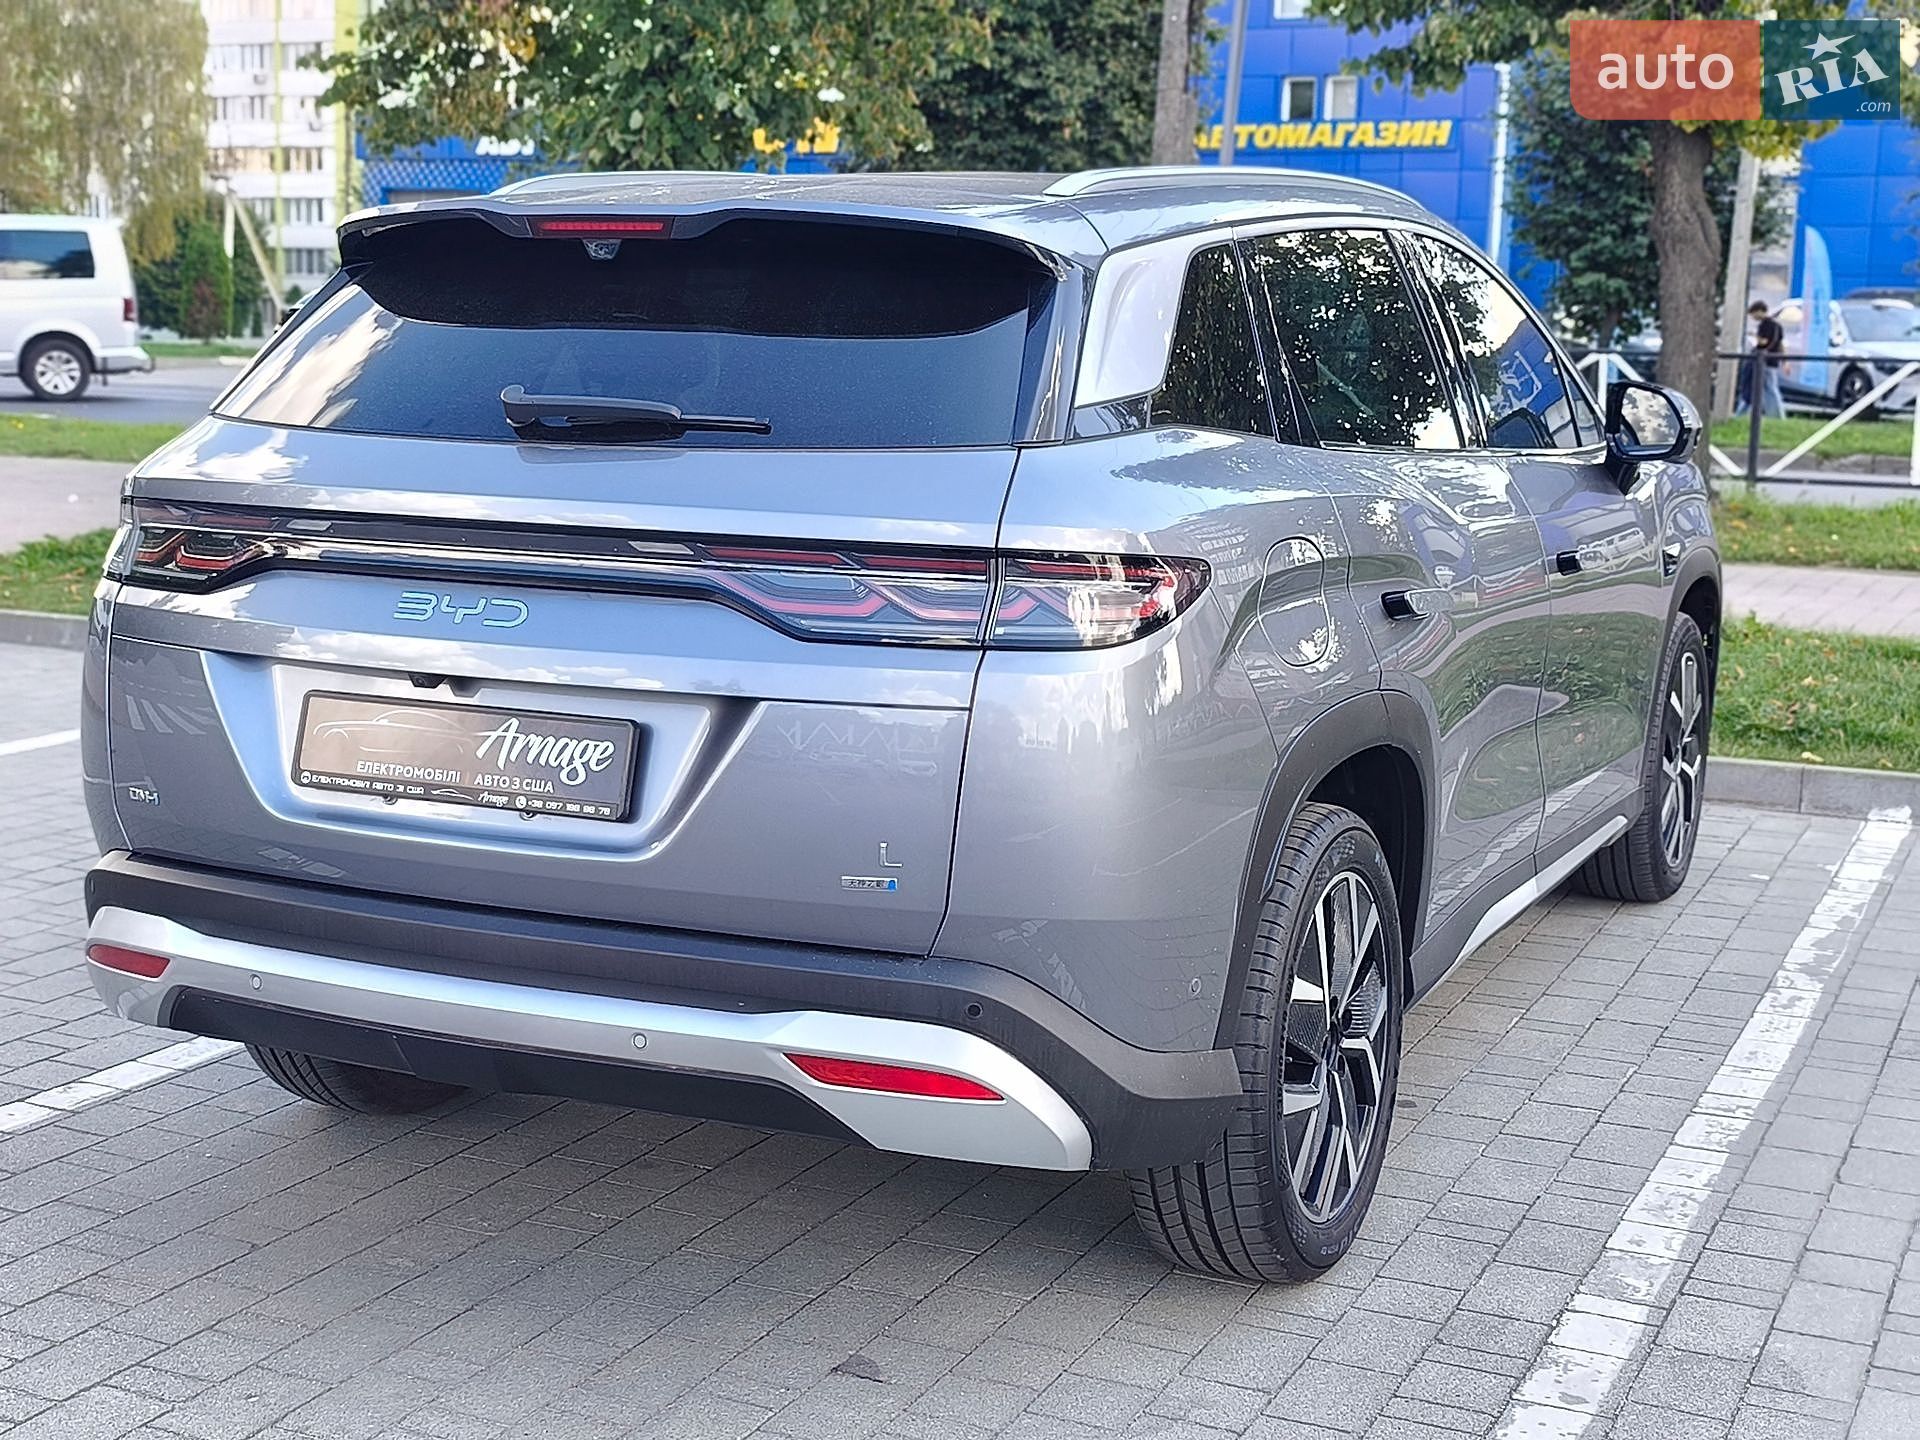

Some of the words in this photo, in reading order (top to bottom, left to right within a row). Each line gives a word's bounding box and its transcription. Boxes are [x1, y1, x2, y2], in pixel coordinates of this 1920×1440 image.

[393, 591, 529, 628] BYD
[475, 717, 615, 786] Arnage
[357, 760, 461, 783] ЕЛЕКТРОМОБІЛІ
[474, 773, 510, 788] АВТО
[522, 779, 554, 793] США
[880, 842, 903, 867] L
